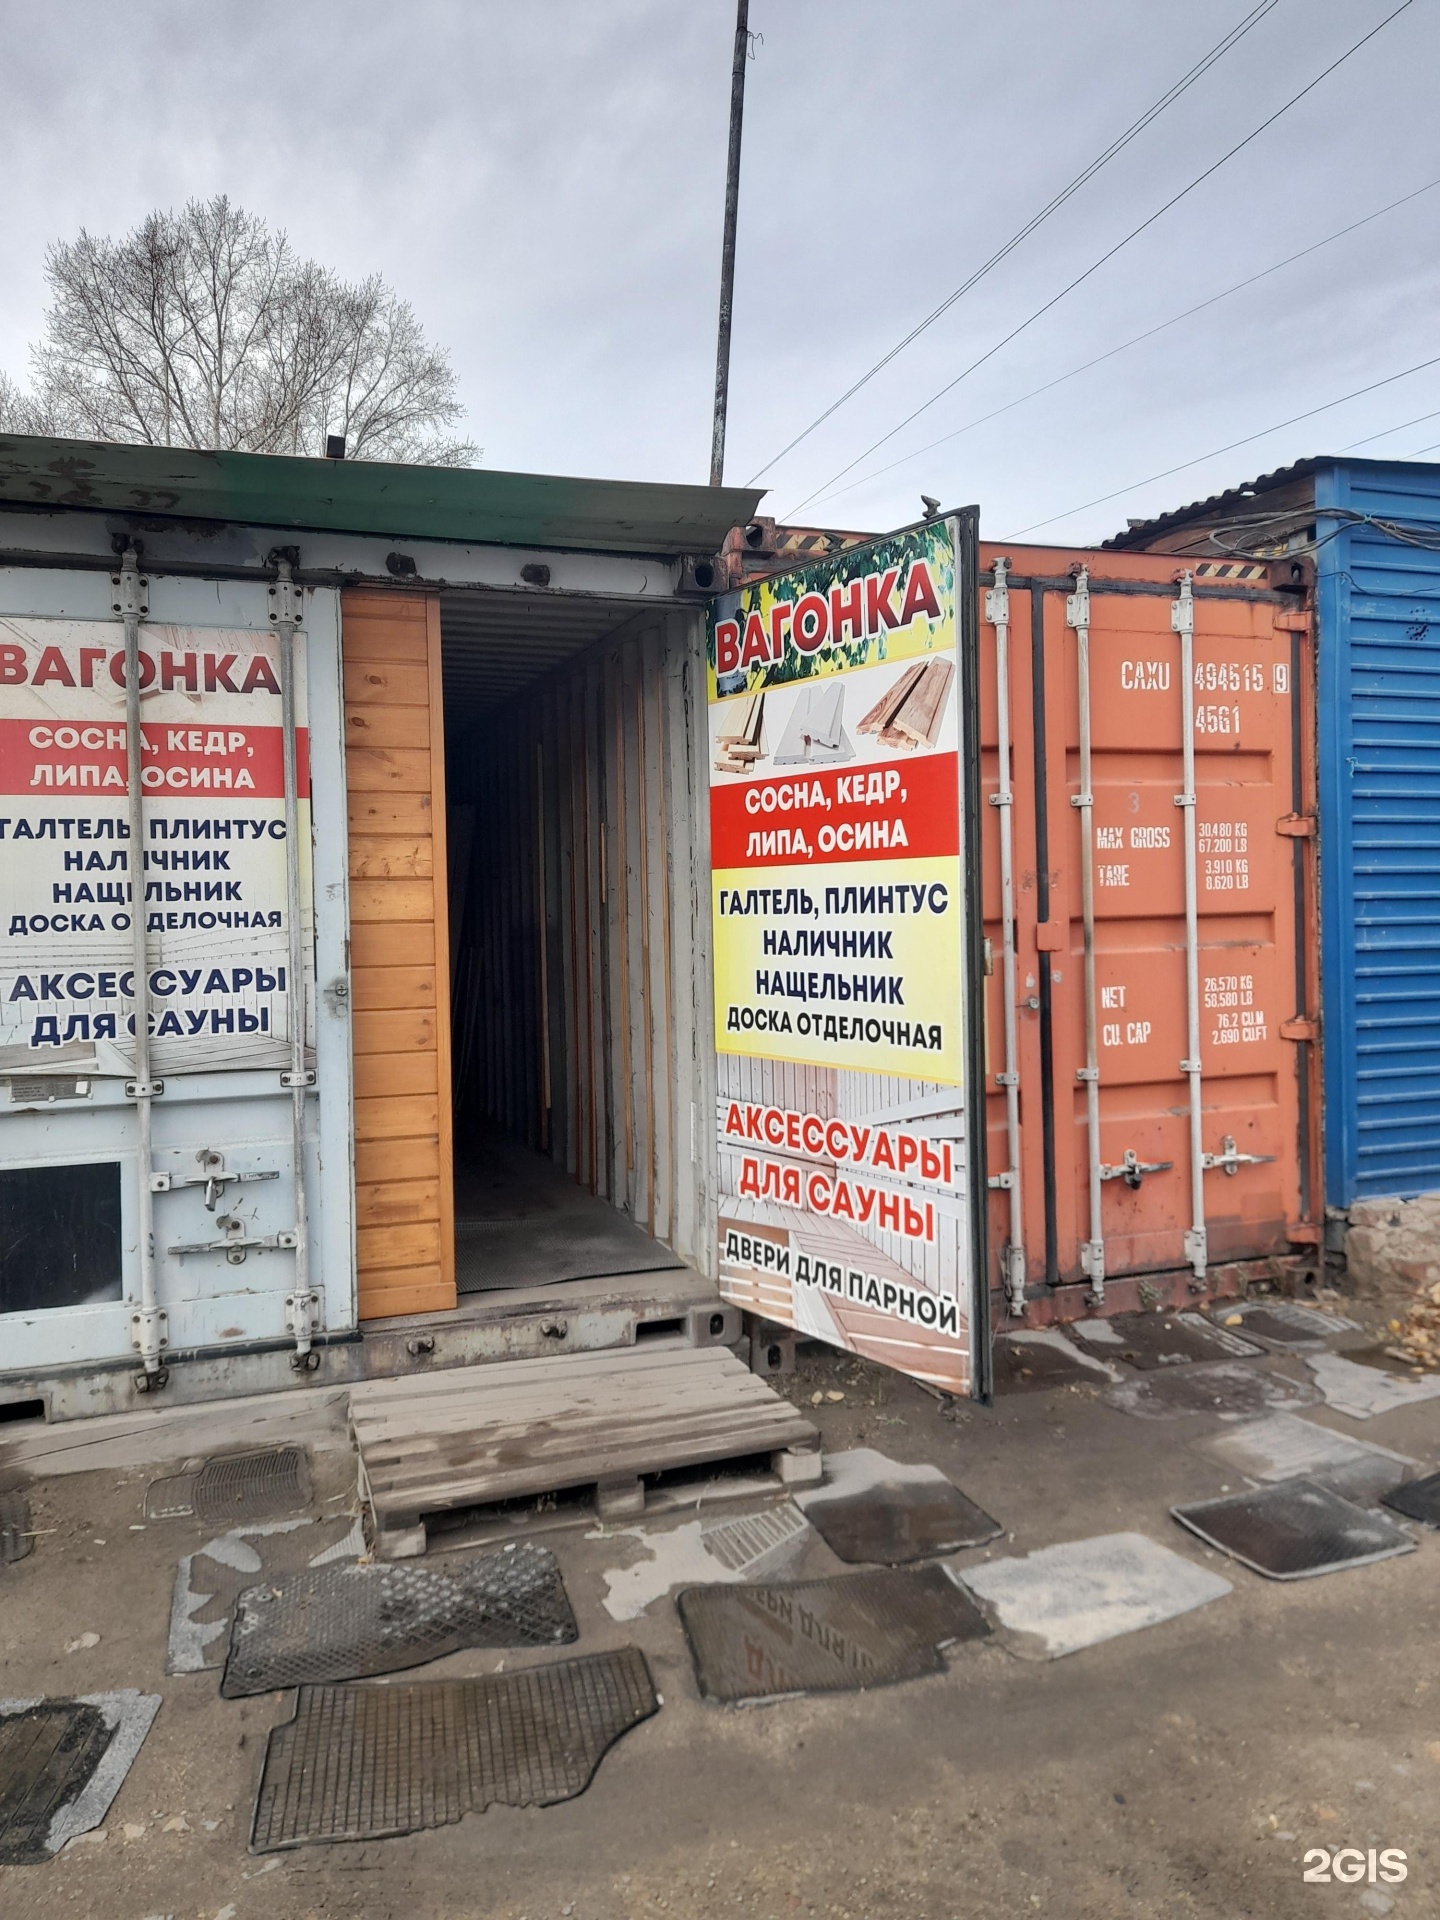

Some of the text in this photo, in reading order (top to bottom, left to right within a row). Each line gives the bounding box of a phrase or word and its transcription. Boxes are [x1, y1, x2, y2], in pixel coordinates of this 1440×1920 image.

[716, 562, 941, 674] ВАГОНКА
[0, 644, 282, 695] ВАГОНКА
[1121, 661, 1288, 692] CAXU 494515 9
[1196, 706, 1240, 733] 45G1
[167, 730, 254, 757] КЕДР,
[141, 765, 256, 789] ОСИНА
[745, 770, 908, 814] СОСНА, КЕДР,
[150, 818, 287, 840] ПЛИНТУС
[746, 819, 909, 858] ЛИПА, ОСИНА
[1097, 827, 1170, 849] MAX GROSS
[1235, 823, 1248, 837] KG
[1235, 838, 1247, 853] LB
[64, 850, 230, 871] НАЛЧНИК
[1236, 859, 1248, 873] KG
[1098, 865, 1130, 886] TARE
[1237, 875, 1249, 889] LB
[720, 883, 948, 920] ГАЛТЕЛЬ, ПЛИНТУС
[9, 910, 282, 936] ДОСКА ОДЕЛОЧНАЯ
[763, 930, 893, 959] НАЛИЧНИК
[10, 967, 286, 1001] АКСЕССУАРЫ
[756, 970, 904, 1004] НАЩЕЛЬНИК
[1240, 975, 1253, 990] KG
[1102, 986, 1126, 1009] NET
[1241, 991, 1253, 1006] LB
[31, 1013, 116, 1047] ДЛЯ
[727, 1007, 942, 1050] ДОСКА ОТДЕЛОЧНАЯ
[1104, 1022, 1151, 1046] CU. CAP
[726, 1102, 951, 1183] АКСЕССУАРЫ
[740, 1159, 934, 1242] ДЛЯ САУНЫ
[726, 1234, 957, 1334] ДВЕРИ ДЛЯ ПАРНОЙ
